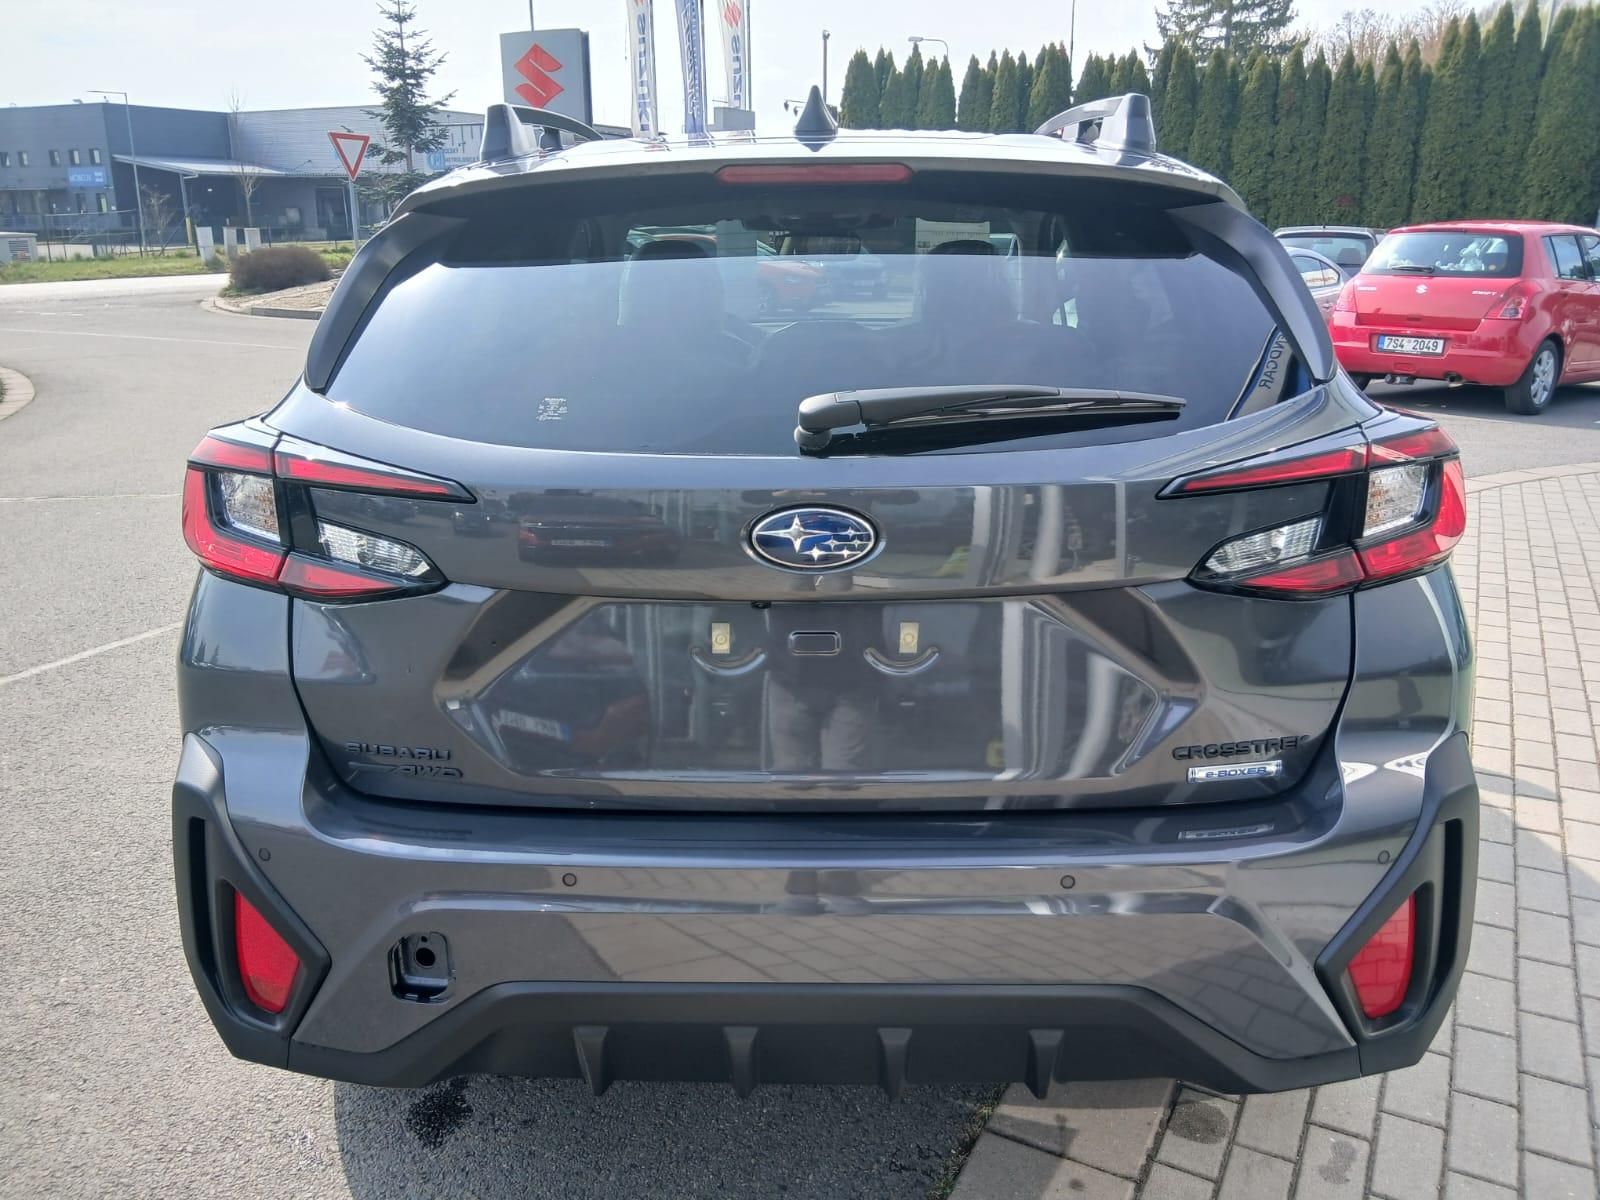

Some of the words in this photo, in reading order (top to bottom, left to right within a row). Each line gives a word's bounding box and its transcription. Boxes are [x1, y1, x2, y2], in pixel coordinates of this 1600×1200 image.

[1386, 337, 1405, 350] 7S4
[1412, 339, 1439, 351] 2049
[345, 741, 451, 761] SUBARU
[1205, 766, 1268, 779] e-BOXER
